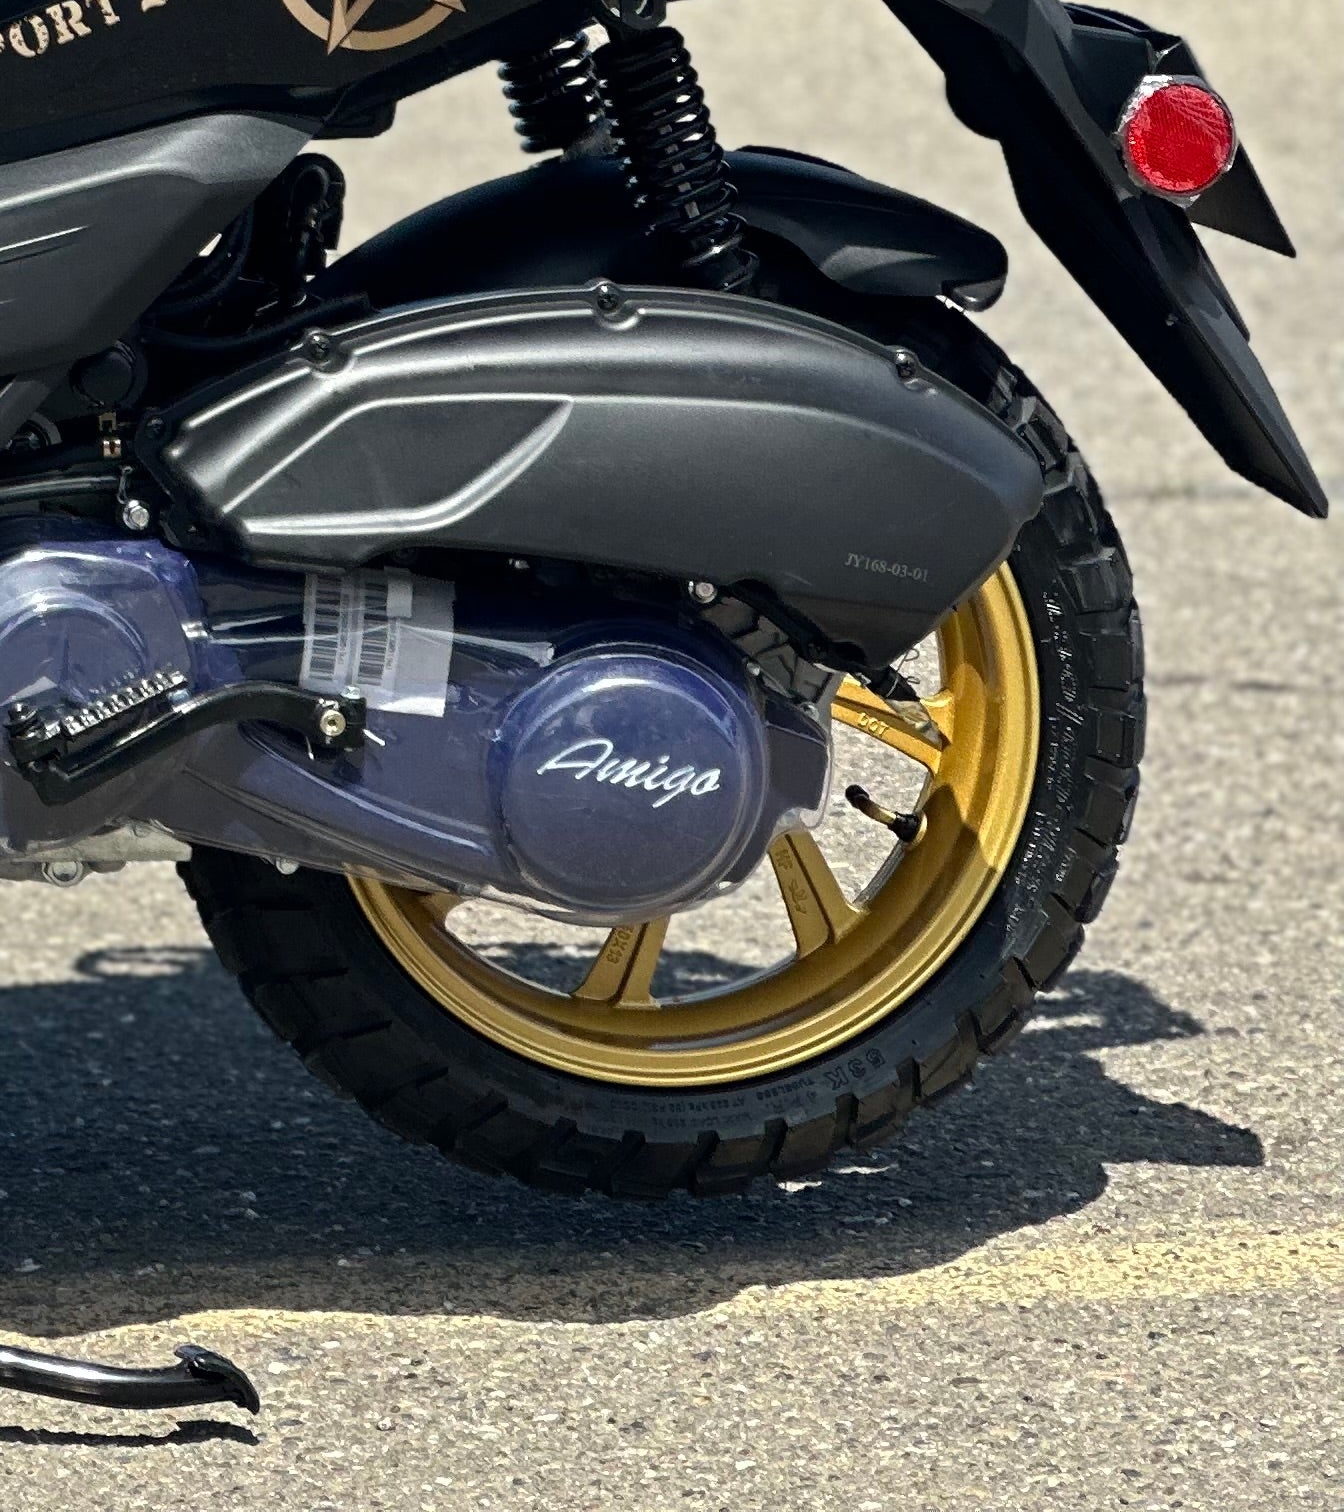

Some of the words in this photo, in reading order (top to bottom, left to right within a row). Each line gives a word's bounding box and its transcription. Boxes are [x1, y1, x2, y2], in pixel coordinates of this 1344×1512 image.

[844, 553, 930, 582] JY168-03-01
[537, 738, 721, 808] Amigo
[825, 1048, 885, 1090] 53K
